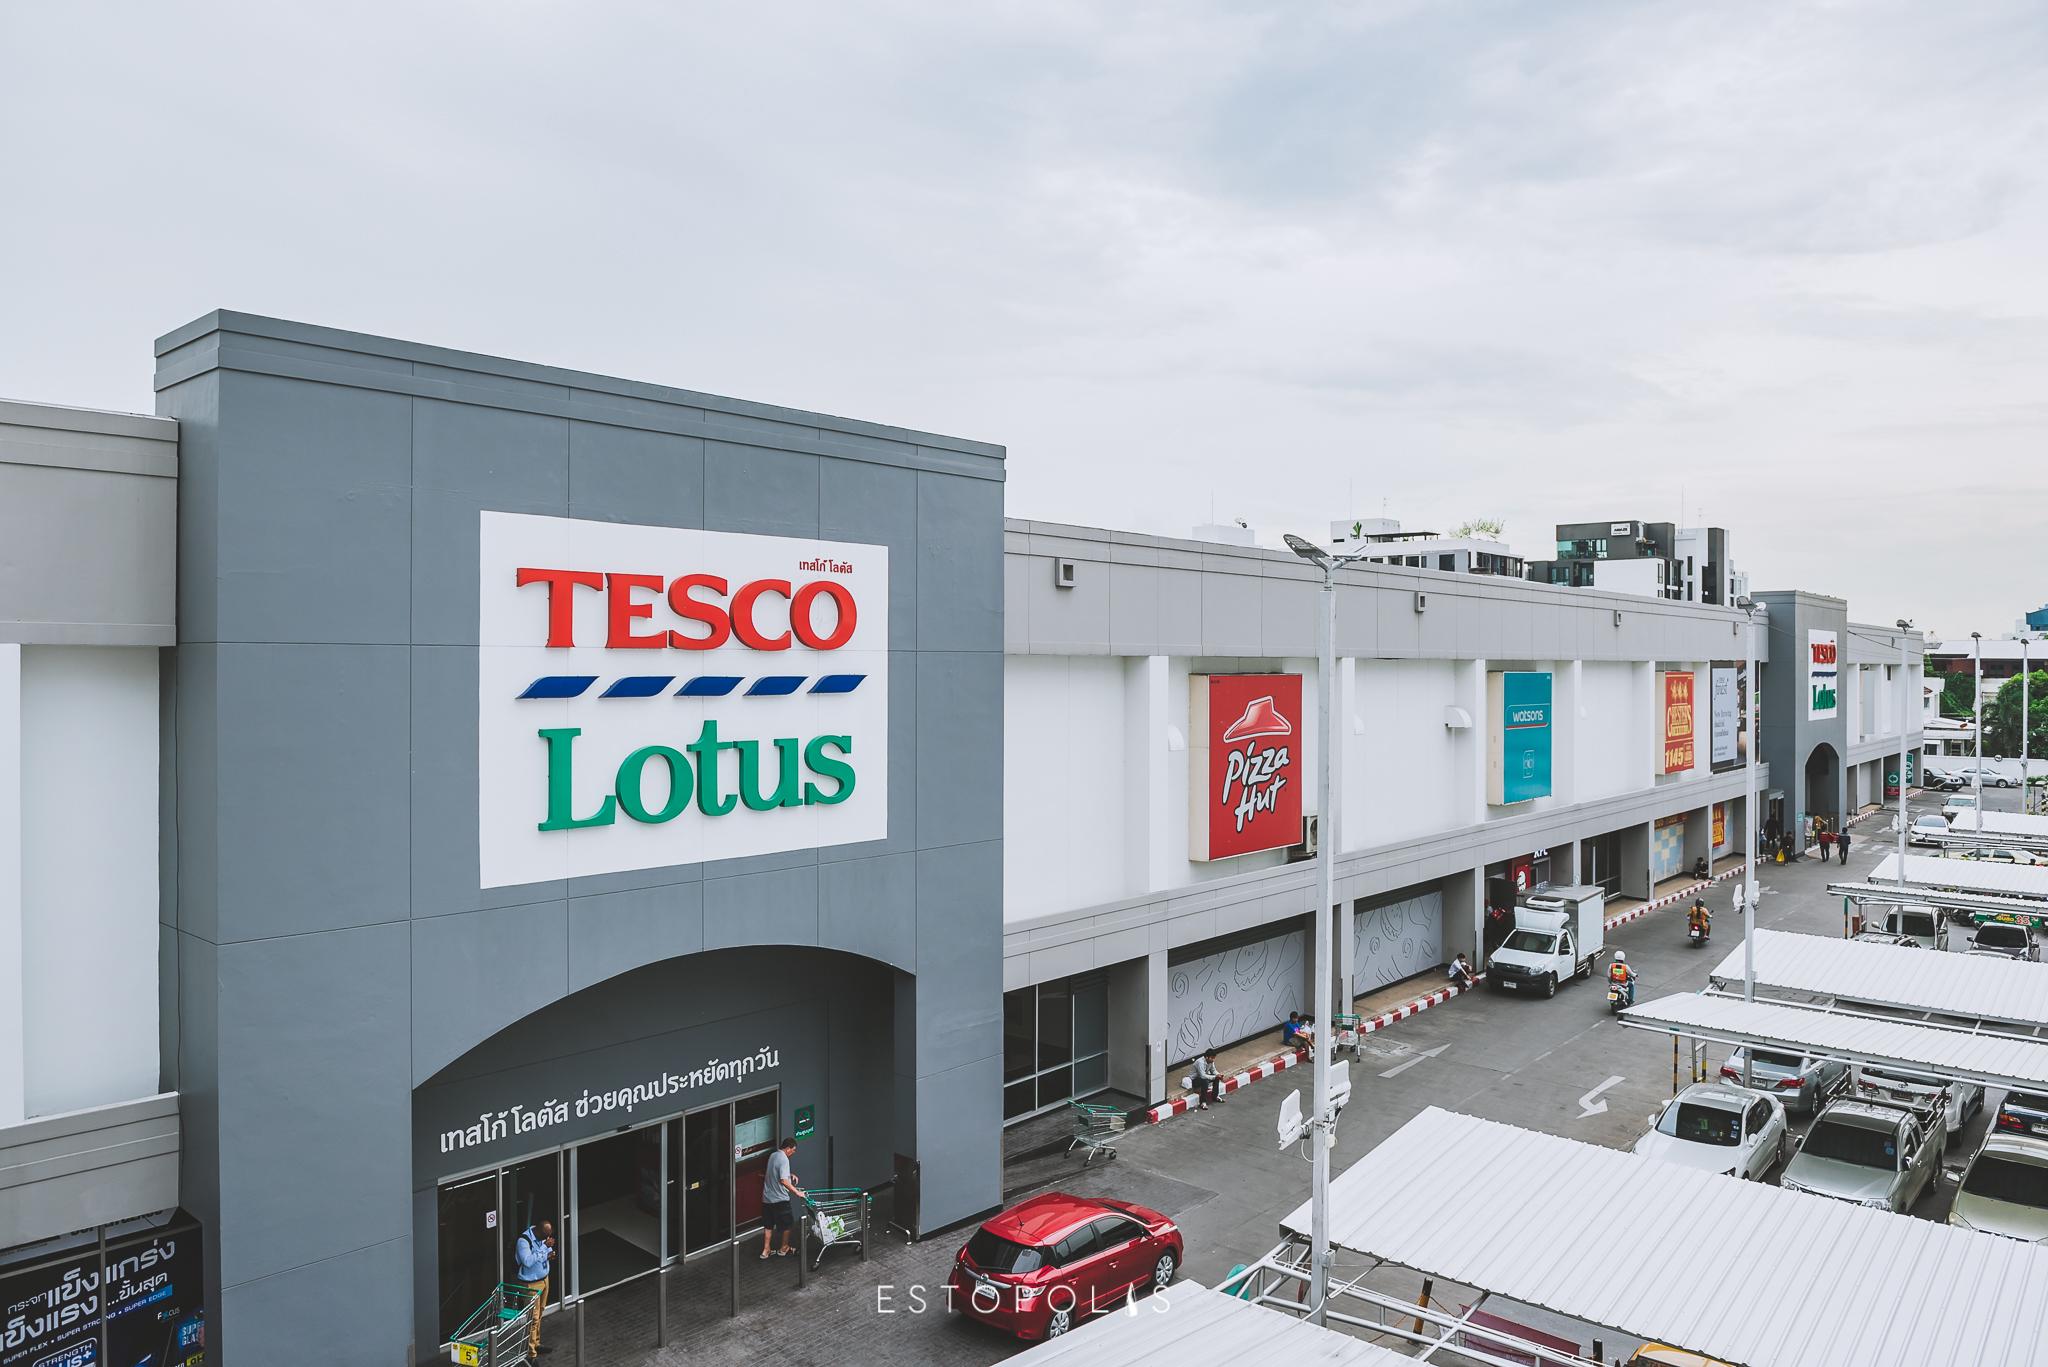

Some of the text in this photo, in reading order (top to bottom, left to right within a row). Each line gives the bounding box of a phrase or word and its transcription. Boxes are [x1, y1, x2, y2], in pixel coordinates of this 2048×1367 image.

[799, 558, 853, 574] เทสโก้ โลตัส
[516, 568, 857, 651] TESCO
[1512, 710, 1544, 722] watsons
[538, 720, 856, 832] Lotus
[1222, 741, 1290, 805] Pizza
[1234, 775, 1287, 833] Hut
[440, 1046, 780, 1153] เทสโก้ โลตัส ช่วยคุณประหยัดทุกวัน
[29, 1341, 48, 1353] FLEX
[57, 1327, 81, 1341] SUPER
[124, 1300, 147, 1313] SUPER
[148, 1291, 166, 1302] EDGE
[39, 1343, 92, 1367] STRENGTH
[465, 1351, 472, 1361] 5
